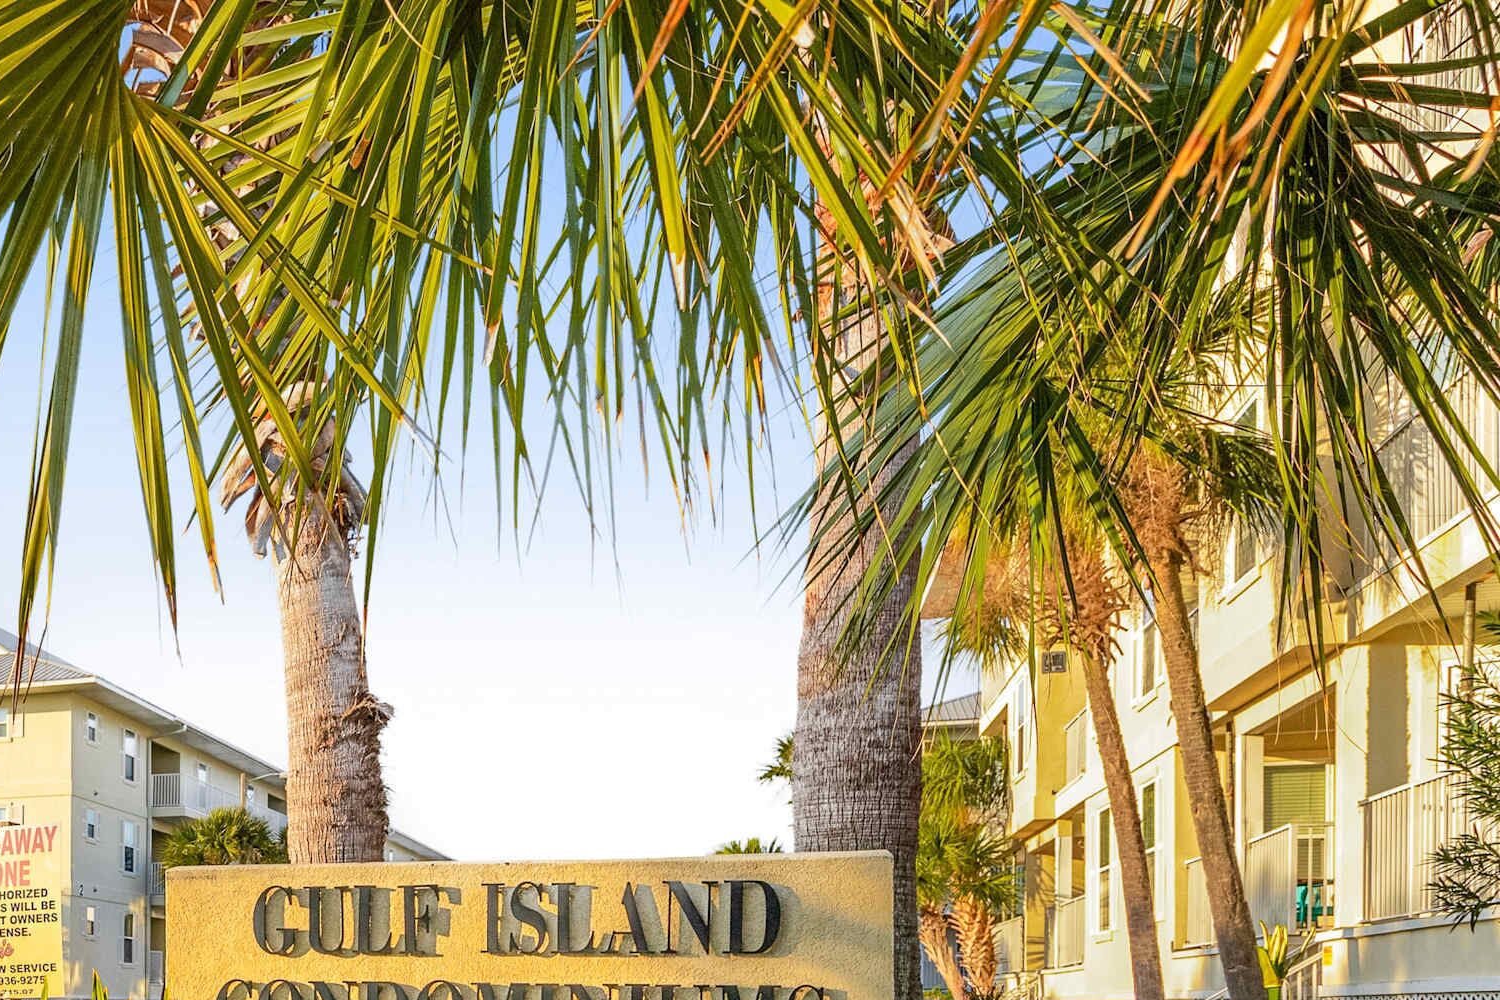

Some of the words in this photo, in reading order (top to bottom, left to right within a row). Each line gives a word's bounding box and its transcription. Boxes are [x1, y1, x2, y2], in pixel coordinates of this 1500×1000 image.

[11, 902, 38, 913] WILL
[41, 900, 56, 910] BE
[10, 913, 58, 925] OWNERS
[253, 885, 440, 955] GULF
[481, 880, 781, 955] ISLAND
[10, 963, 57, 973] SERVICE
